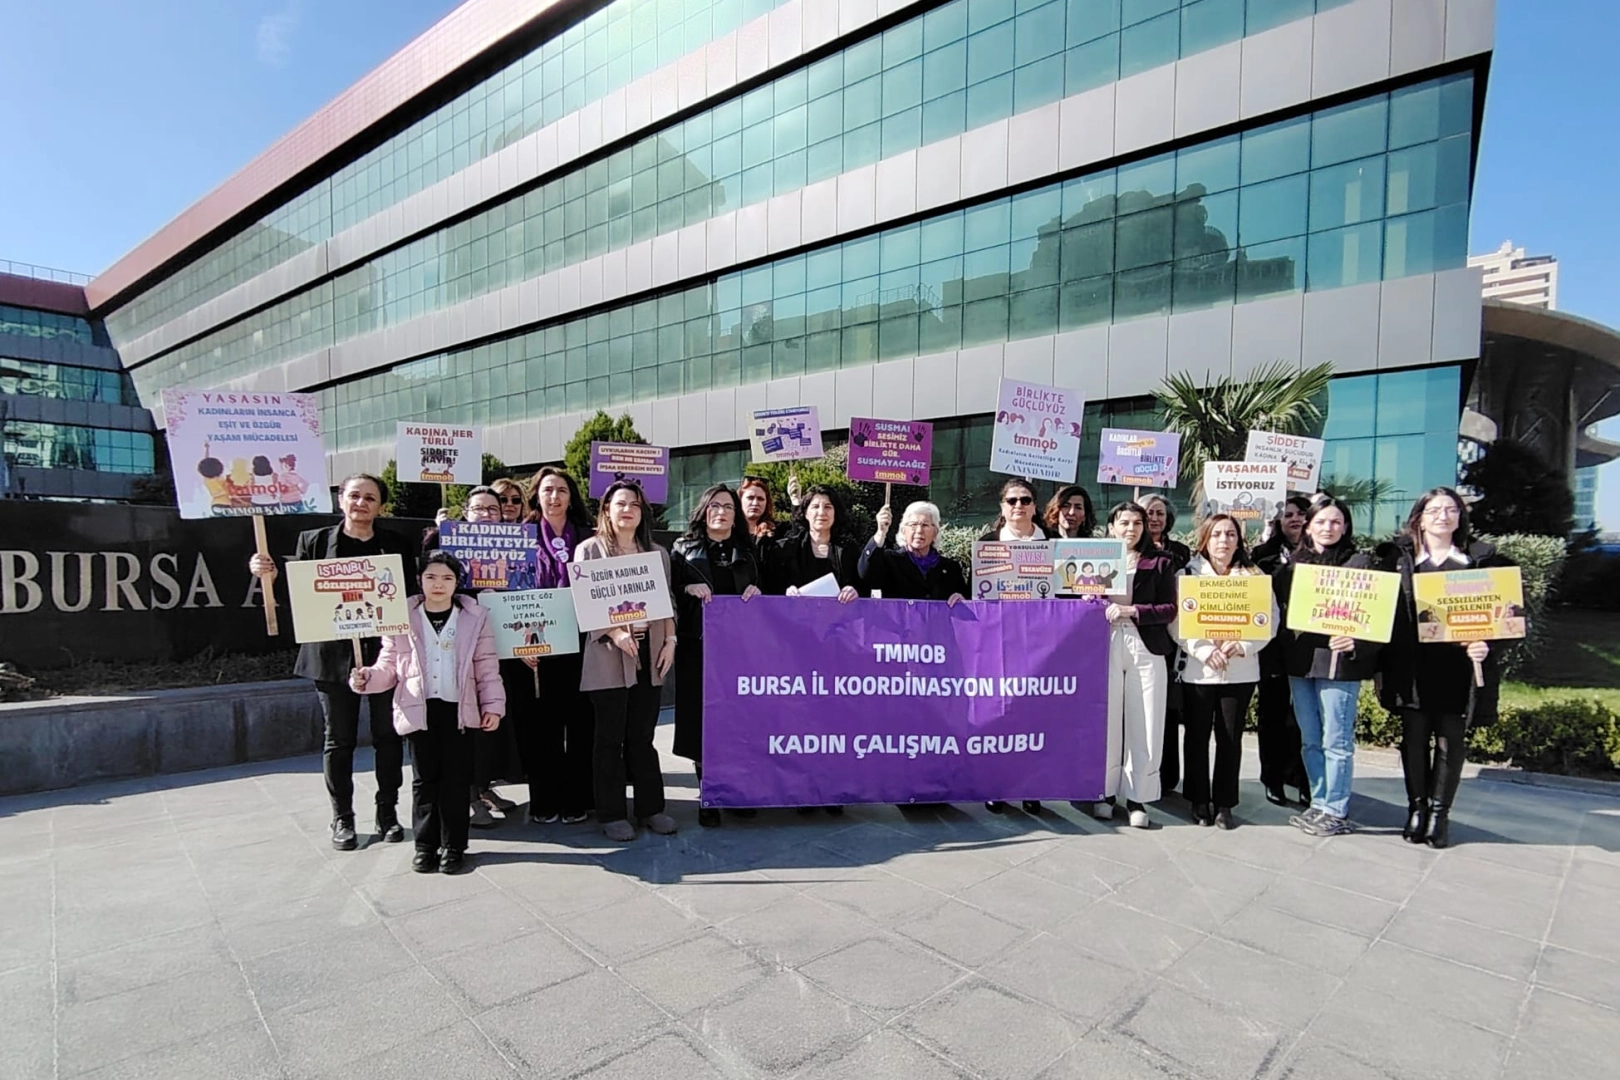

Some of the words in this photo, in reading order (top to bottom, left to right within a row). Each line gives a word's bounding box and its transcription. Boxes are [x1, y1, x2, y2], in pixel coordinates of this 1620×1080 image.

[1016, 386, 1064, 403] BİRLİKTE
[1012, 397, 1066, 415] GÜÇLÜYÜZ
[198, 407, 255, 416] KADINLARIN
[257, 407, 296, 417] İNSANCA
[218, 421, 236, 430] EŞİT
[240, 421, 250, 429] VE
[253, 420, 282, 429] ÖZGÜR
[875, 423, 911, 433] SUSMA!
[207, 433, 241, 443] YAŞAM
[243, 432, 298, 442] MÜCADELESİ
[406, 427, 448, 437] KADINA
[452, 429, 473, 438] HER
[877, 432, 908, 441] SESİMİZ
[421, 436, 454, 446] TÜRLÜ
[863, 440, 898, 449] BİRLİKTE
[1013, 433, 1058, 453] tmmob
[857, 457, 927, 469] SUSMAYACAĞIZ
[1140, 453, 1165, 464] BİRLİKTE
[874, 470, 907, 480] tmmob
[1217, 464, 1278, 477] YAŞAMAK
[421, 472, 454, 481] tmmob
[1216, 478, 1276, 490] İSTİYORUZ
[458, 523, 521, 536] KADINIZ
[441, 535, 538, 549] BİRLİKTEYİZ
[454, 548, 526, 561] GÜÇLÜYÜZ
[590, 568, 614, 582] ÖZGÜR
[615, 565, 649, 579] KADINLAR
[0, 550, 225, 613] BURSA
[1199, 579, 1249, 587] EKMEĞİME
[590, 583, 616, 601] GÜÇLÜ
[617, 580, 656, 596] YARINLAR
[1072, 584, 1105, 593] tmmob
[502, 594, 536, 603] ŞİDDETE
[539, 592, 554, 600] GÖZ
[1000, 592, 1031, 600] tmmob
[1200, 591, 1248, 599] BEDENİME
[1199, 602, 1251, 611] KİMLİĞİME
[513, 611, 546, 619] UTANCA
[610, 610, 646, 622] tmmob
[1200, 614, 1247, 623] DOKUNMA
[376, 623, 409, 634] tmmob
[1321, 622, 1356, 634] tmmob
[513, 646, 551, 655] tmmob
[873, 643, 946, 664] TMMOB
[737, 676, 806, 696] BURSA
[811, 671, 829, 696] İL
[834, 671, 994, 697] KOORDİNASYON
[1000, 676, 1077, 696] KURULU
[768, 735, 846, 754] KADIN
[853, 735, 960, 759] ÇALIŞMA
[966, 733, 1045, 754] GRUBU
